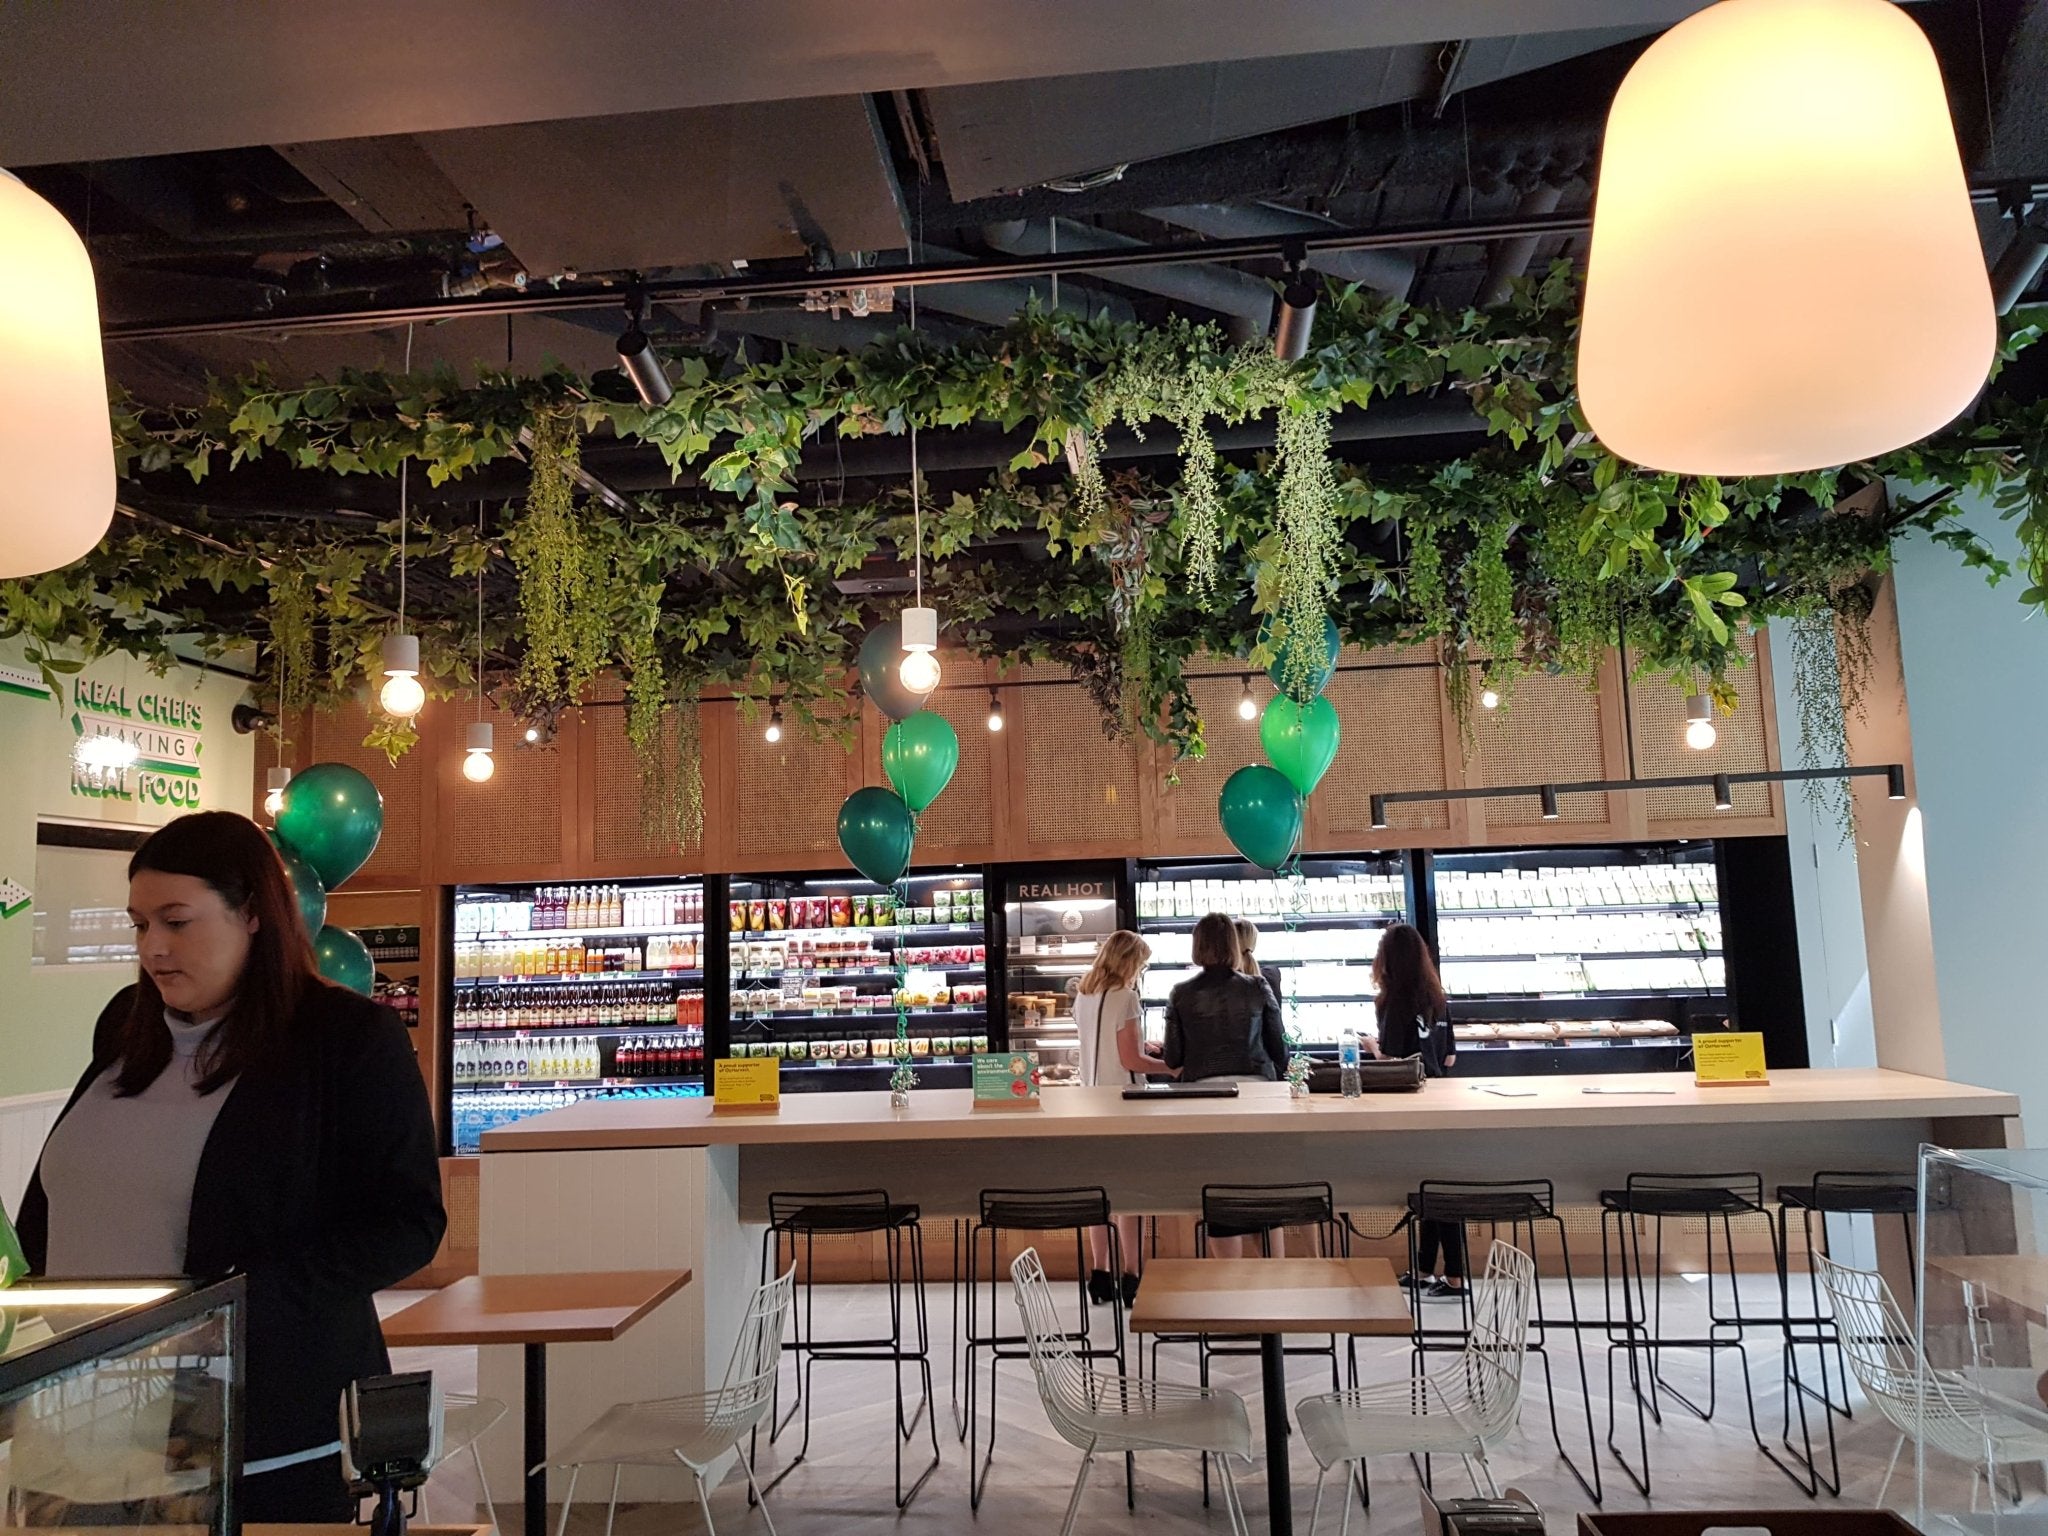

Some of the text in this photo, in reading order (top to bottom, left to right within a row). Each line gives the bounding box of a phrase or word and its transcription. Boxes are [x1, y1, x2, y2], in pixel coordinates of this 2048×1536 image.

[74, 677, 203, 731] REAL CHEFS
[138, 772, 201, 809] FOOD
[1019, 882, 1103, 898] REAL HOT
